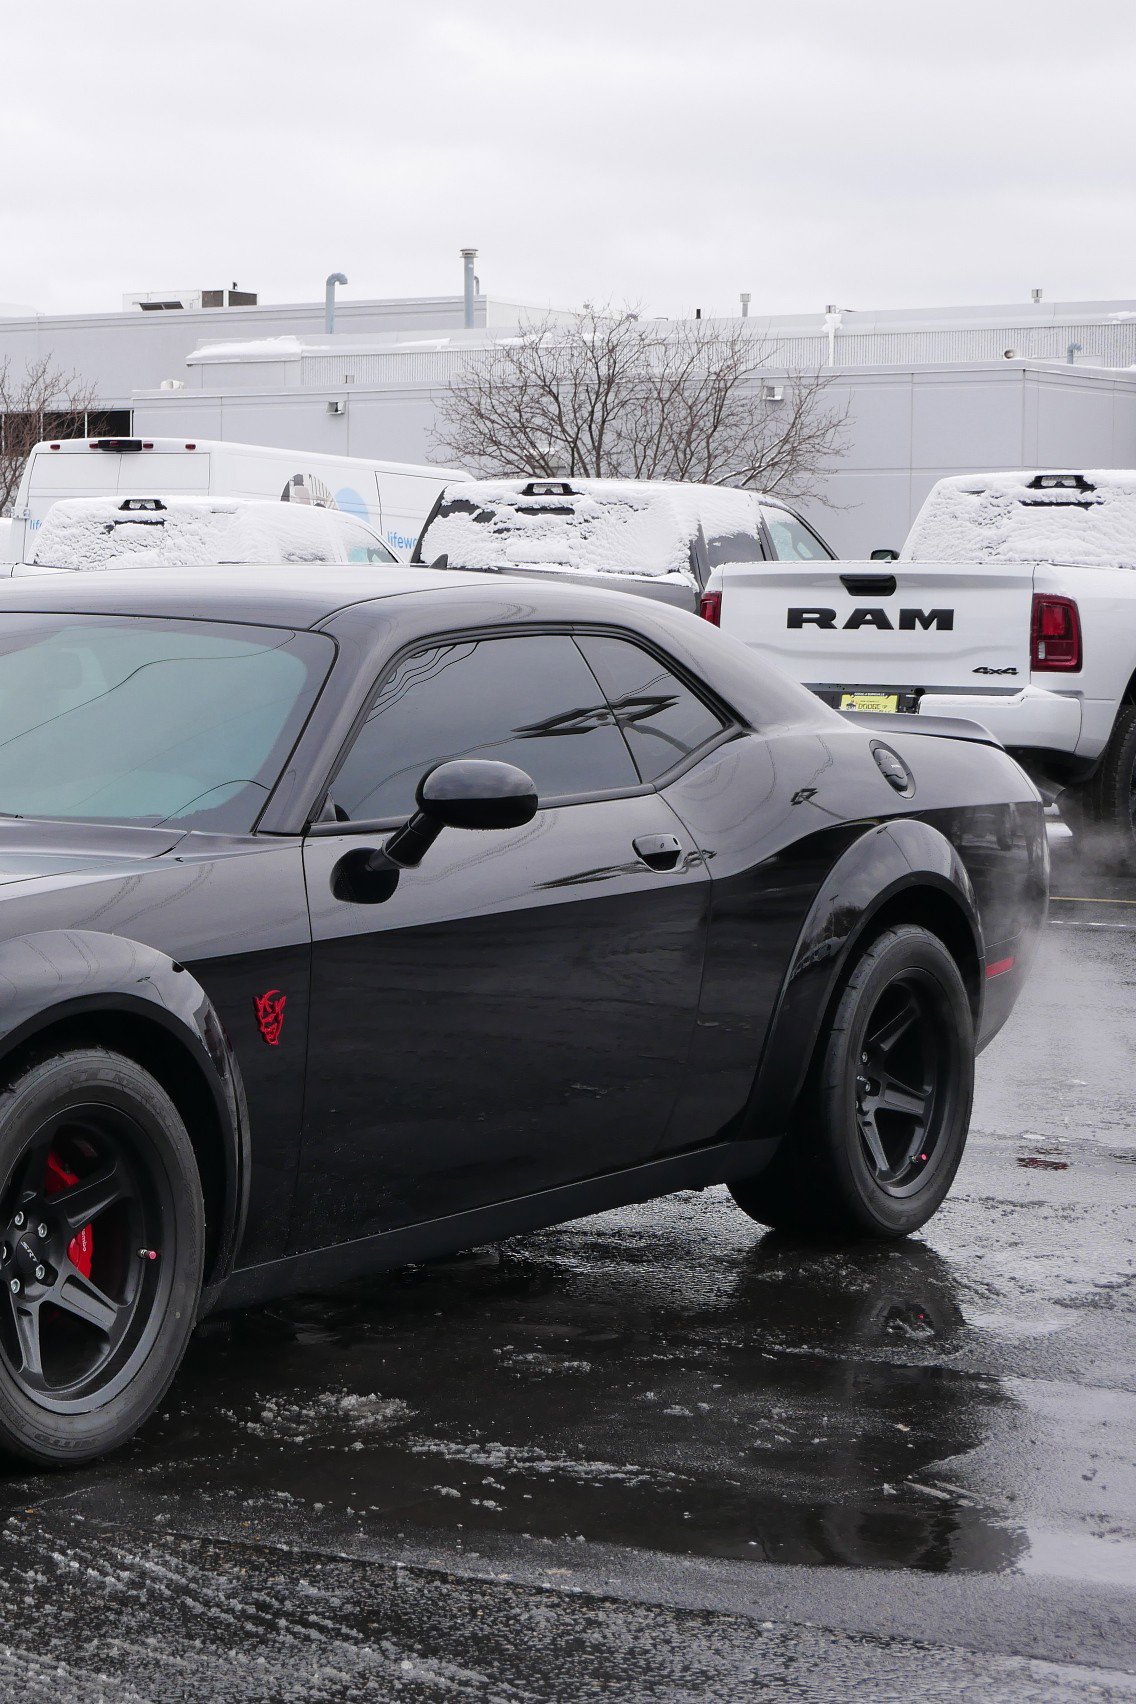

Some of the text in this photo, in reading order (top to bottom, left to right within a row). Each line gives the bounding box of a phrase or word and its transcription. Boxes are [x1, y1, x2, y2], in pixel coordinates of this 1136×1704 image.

[787, 608, 954, 630] RAM
[972, 666, 1019, 676] 4x4
[20, 1241, 39, 1264] SRT
